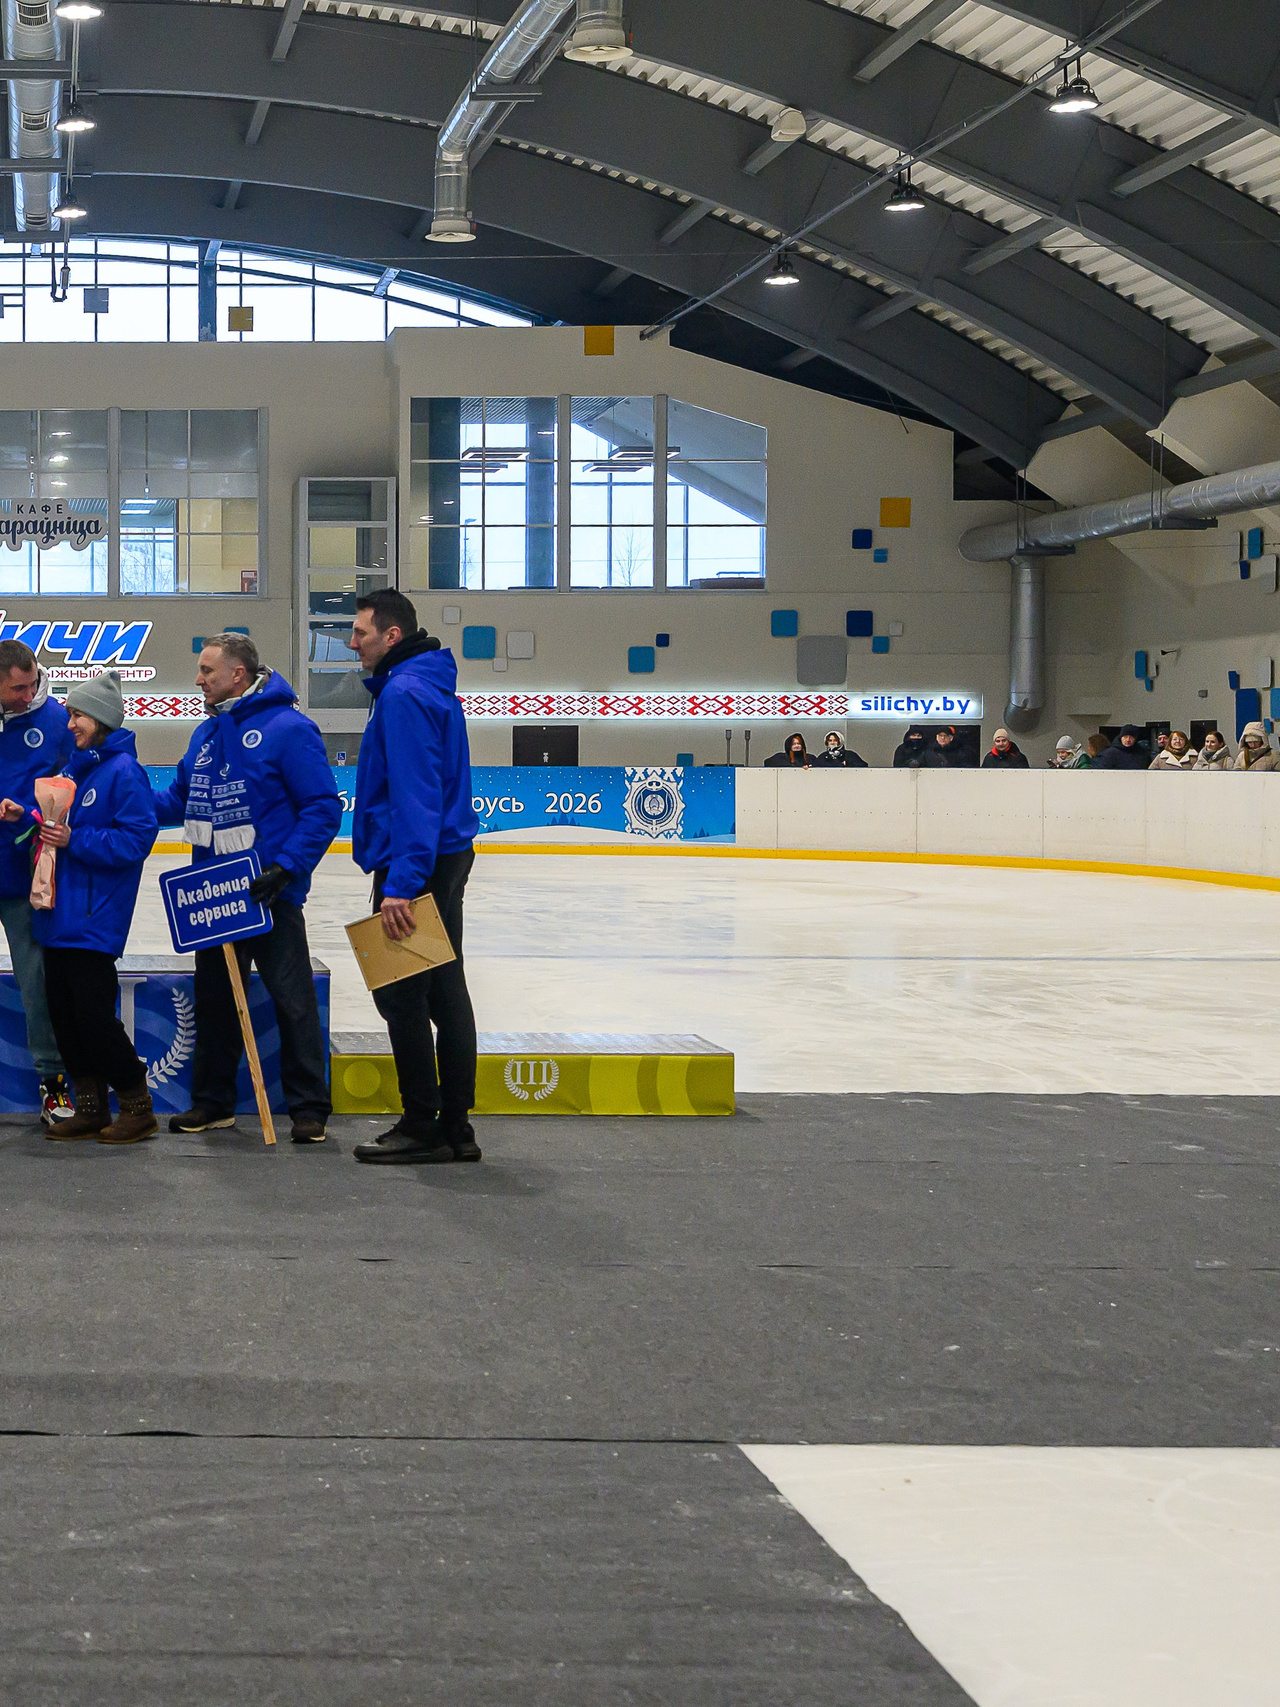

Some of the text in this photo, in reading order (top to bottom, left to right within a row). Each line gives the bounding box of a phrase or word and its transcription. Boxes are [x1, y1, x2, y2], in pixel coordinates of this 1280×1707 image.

[16, 504, 63, 514] КАФЕ
[116, 669, 153, 678] ЕНТР
[861, 696, 970, 715] silichy.by
[544, 792, 603, 815] 2026
[176, 875, 251, 908] Академия
[188, 899, 248, 928] сервиса
[513, 1060, 551, 1085] III
